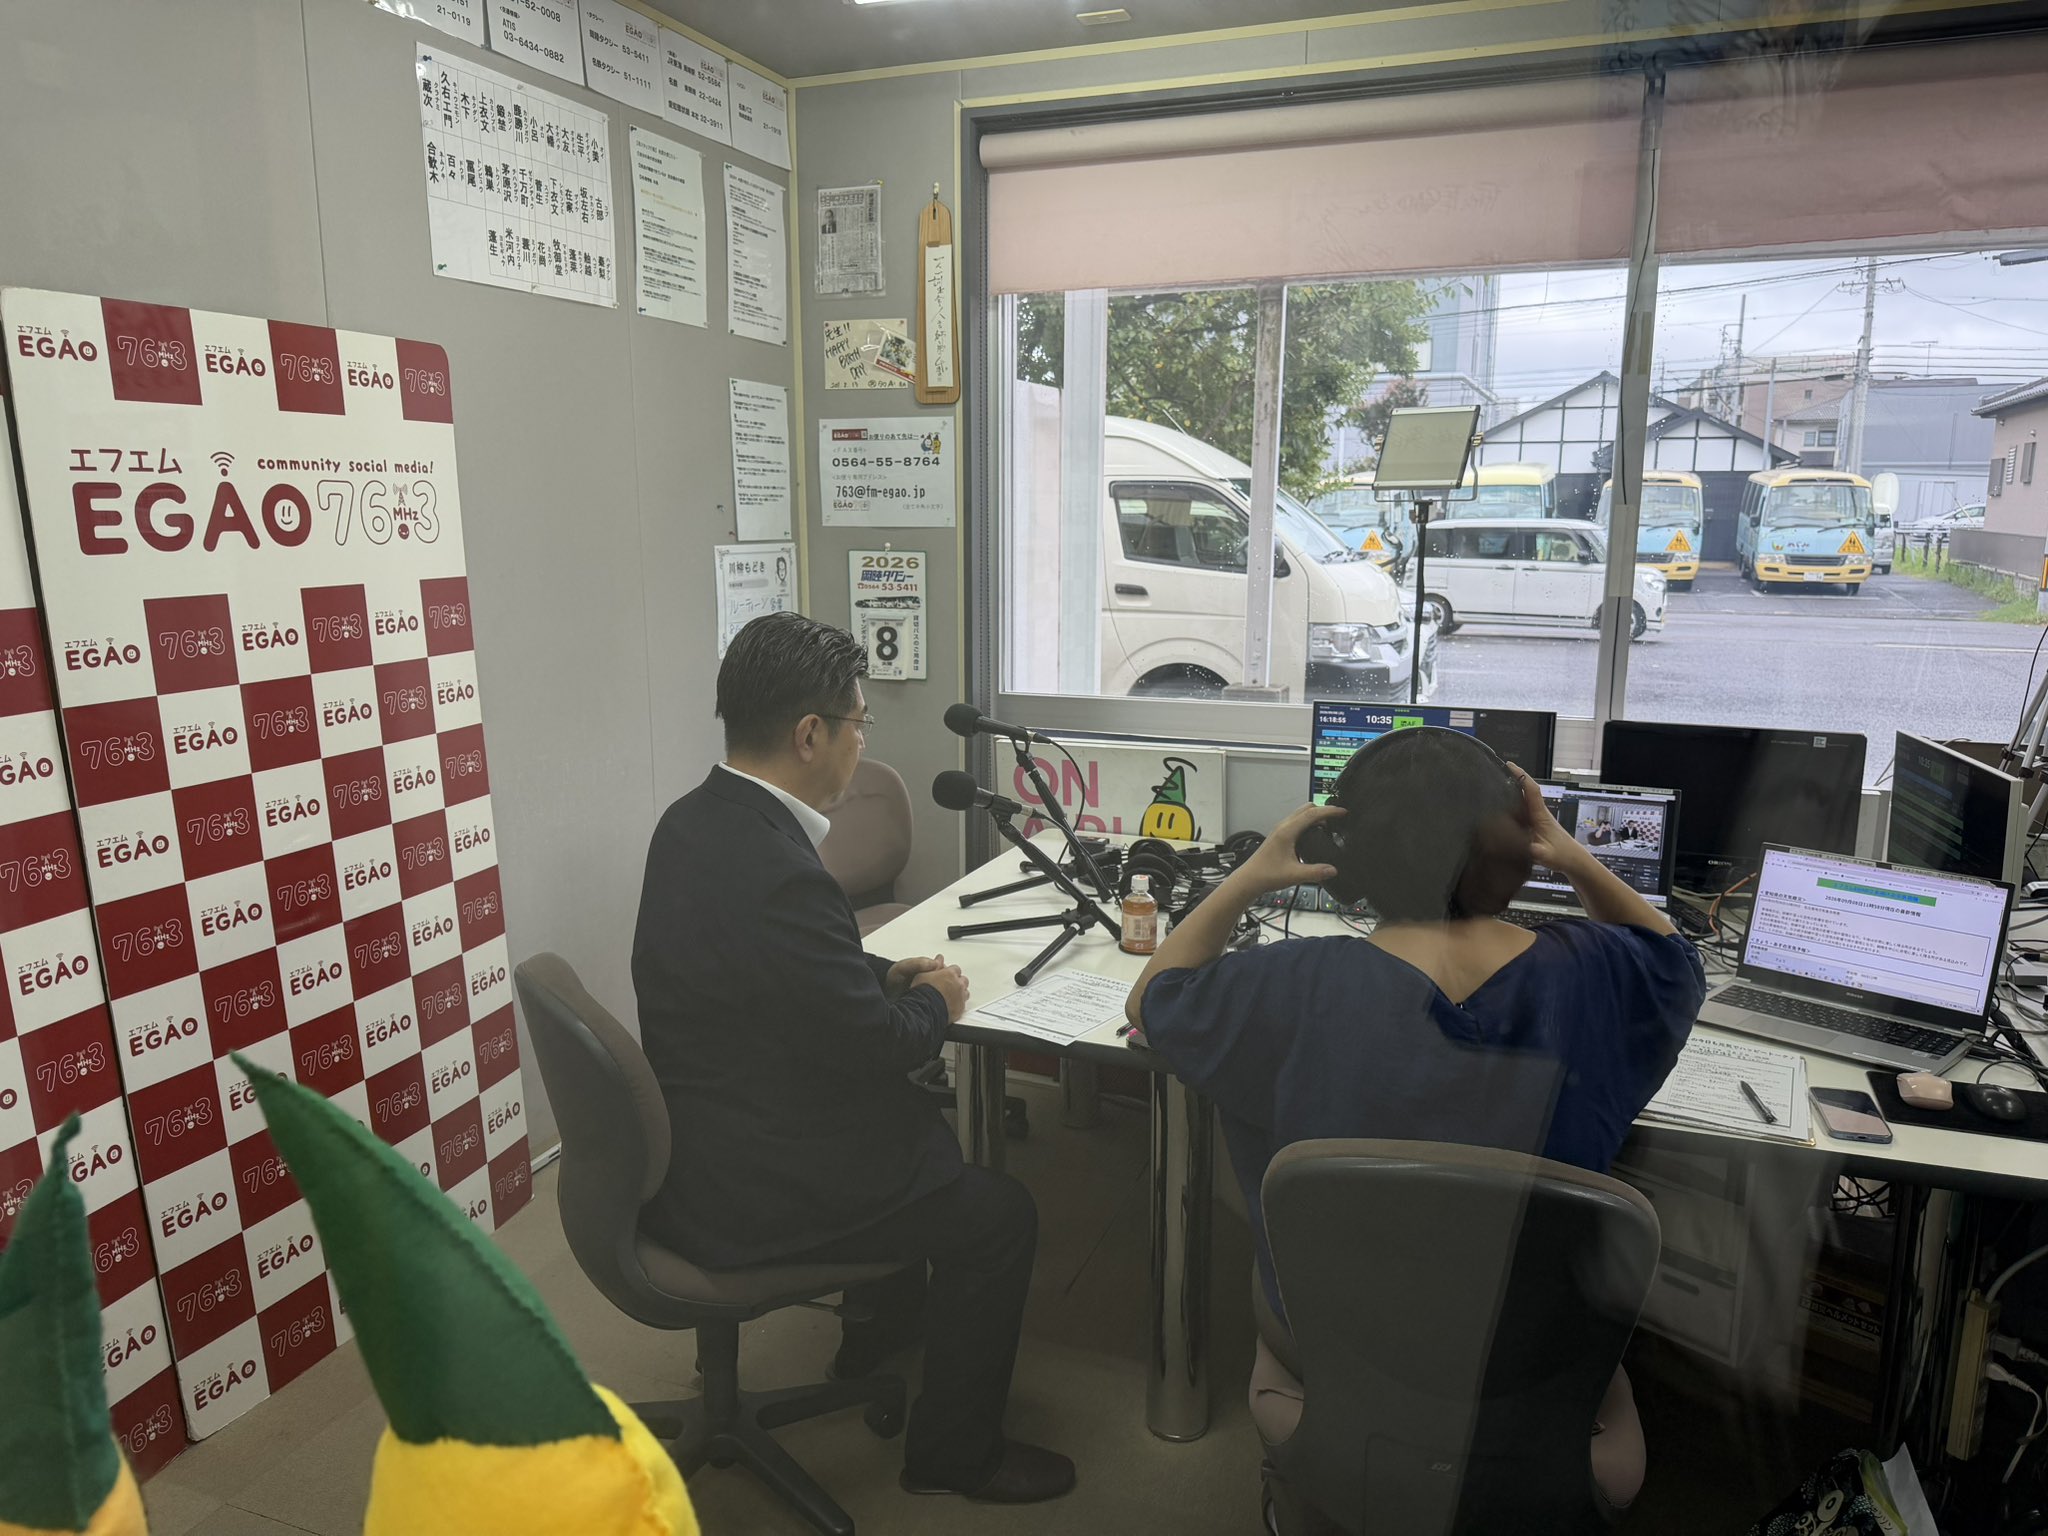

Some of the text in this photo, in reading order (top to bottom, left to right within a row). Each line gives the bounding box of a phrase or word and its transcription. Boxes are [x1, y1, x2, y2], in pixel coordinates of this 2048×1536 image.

[437, 5, 471, 26] 21-0119
[502, 18, 516, 31] ATIS
[503, 31, 564, 63] 03-6434-0882
[622, 45, 649, 63] 53-5411
[624, 72, 651, 89] 51-1111
[461, 92, 469, 119] 木下
[479, 91, 489, 133] 上衣文
[530, 116, 538, 143] 小呂
[562, 128, 570, 153] 大友
[577, 134, 584, 157] 生平
[591, 138, 599, 163] 小美
[447, 154, 455, 179] 百々
[519, 169, 528, 207] 千万町
[550, 178, 558, 215] 下衣文
[580, 187, 588, 224] 坂左右
[505, 228, 514, 266] 米河内
[18, 335, 97, 361] EGAO
[826, 338, 850, 359] HAPPY
[205, 354, 266, 376] EGAO
[347, 369, 393, 389] EGAO
[70, 448, 182, 474] エフエム
[257, 458, 433, 474] community social media!
[832, 457, 940, 467] 0564-55-8764
[836, 485, 925, 498] 763@fm-egao.jp
[72, 481, 312, 555] EGAO
[393, 507, 419, 521] MHz
[862, 556, 919, 569] 2026
[375, 616, 418, 635] EGAO
[242, 628, 299, 651] EGAO
[876, 626, 898, 661] 8
[65, 645, 140, 670] EGAO
[437, 684, 474, 705] EGAO
[323, 703, 372, 727] EGAO
[1366, 715, 1392, 724] 10:35
[174, 727, 238, 754] EGAO
[0, 758, 53, 785] GAO
[394, 769, 435, 794] EGAO
[1013, 757, 1098, 808] ON
[266, 799, 320, 827] EGAO
[97, 835, 169, 868] EGAO
[454, 828, 490, 853] EGAO
[344, 862, 391, 890] EGAO
[201, 903, 262, 936] EGAO
[412, 917, 453, 947] EGAO
[19, 955, 88, 995] EGAO
[290, 962, 342, 996] EGAO
[471, 967, 505, 996] EGAO
[129, 1018, 198, 1057] EGAO
[366, 1015, 411, 1048] EGAO
[432, 1061, 470, 1094] EGAO
[488, 1102, 520, 1134] EGAO
[67, 1144, 122, 1182] GAO
[162, 1192, 228, 1238] EGAO
[257, 1234, 313, 1279] EGAO
[193, 1360, 256, 1411] EGAO
